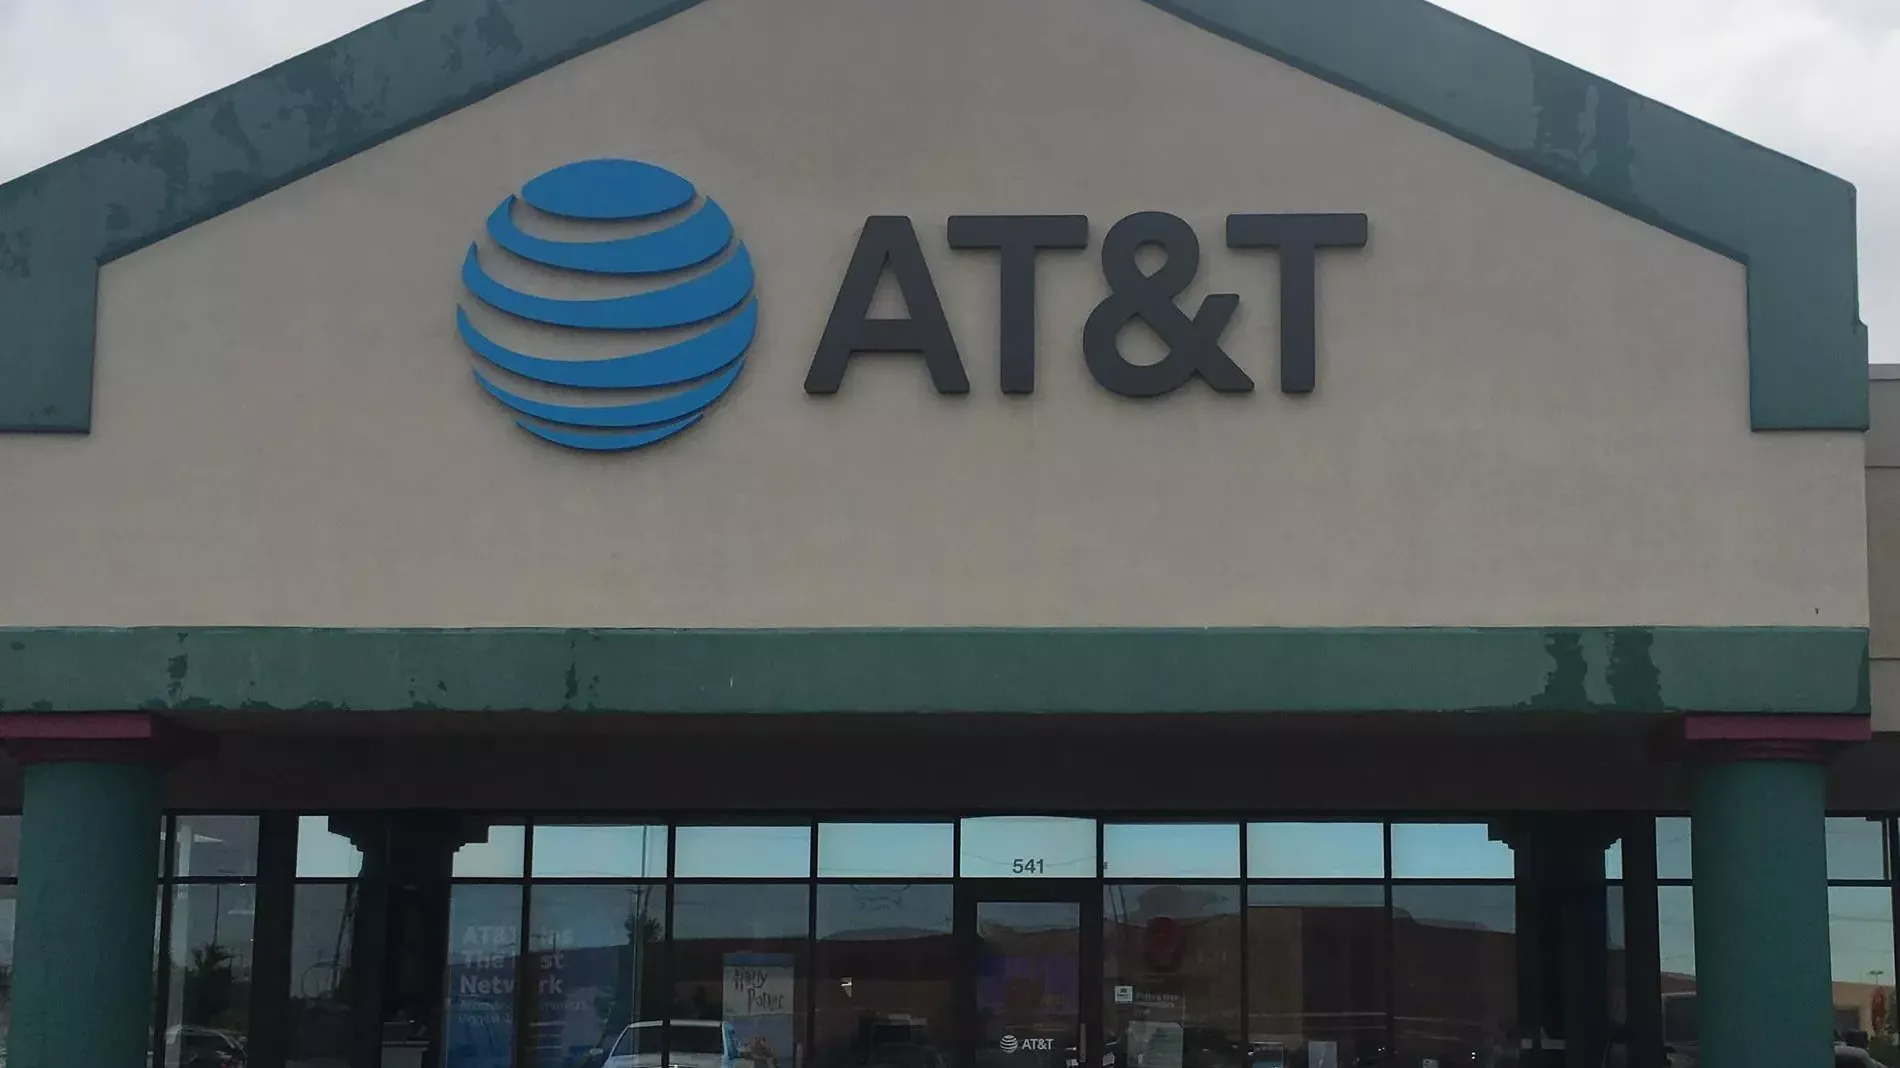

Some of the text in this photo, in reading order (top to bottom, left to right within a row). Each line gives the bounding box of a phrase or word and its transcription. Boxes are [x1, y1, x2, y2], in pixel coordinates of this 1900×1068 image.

[804, 211, 1368, 397] AT&T
[1012, 858, 1045, 875] 541
[459, 973, 563, 994] Netwrk
[731, 968, 768, 992] Harry
[747, 987, 785, 1015] Potter
[1021, 1038, 1055, 1050] AT&T
